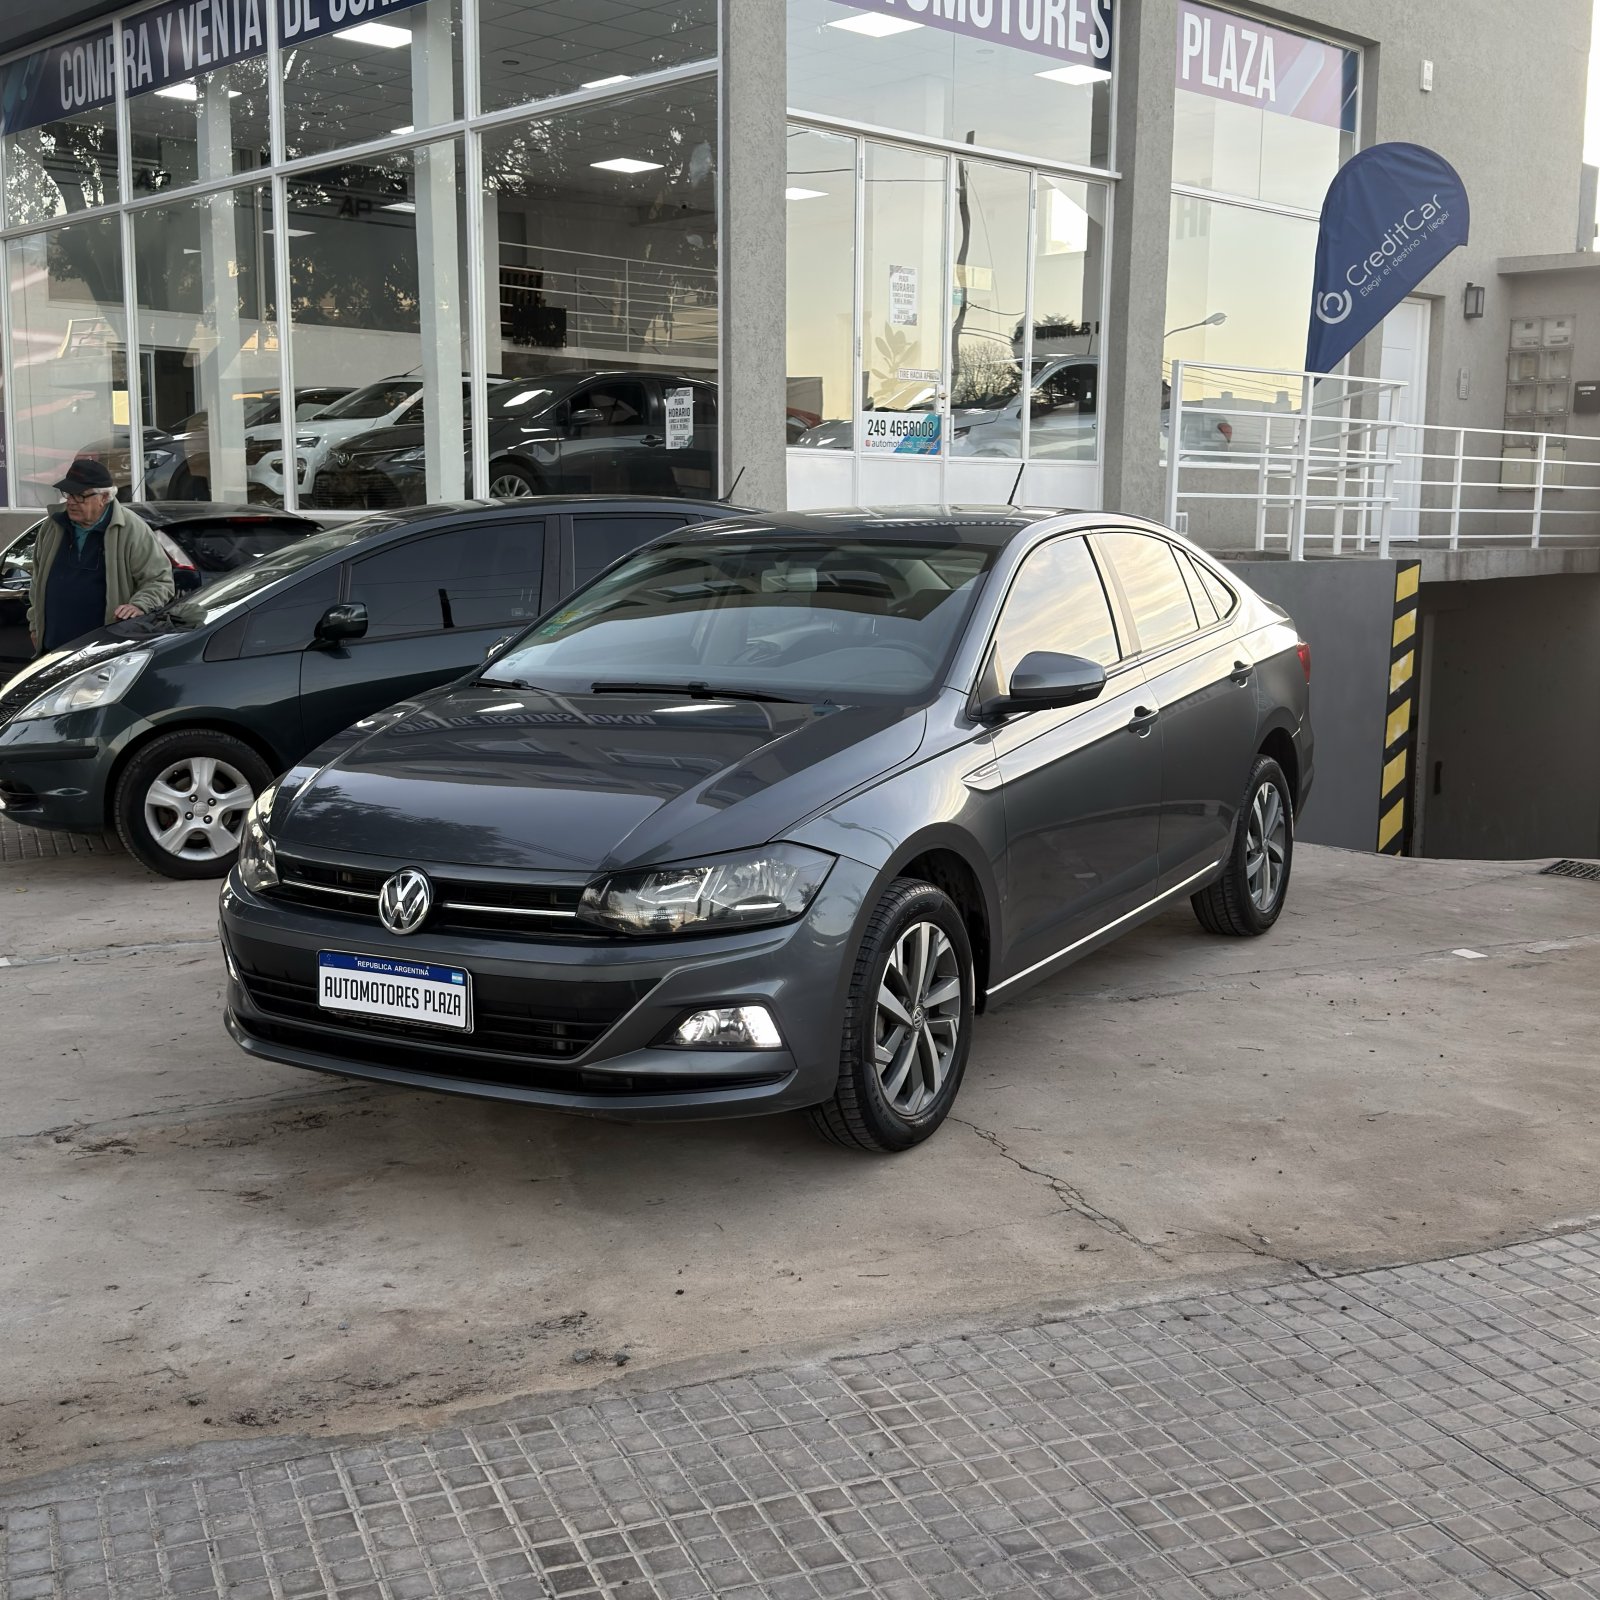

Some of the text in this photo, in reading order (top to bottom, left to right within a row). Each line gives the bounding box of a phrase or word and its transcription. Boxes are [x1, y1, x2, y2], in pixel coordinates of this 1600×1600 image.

[156, 12, 173, 78] Y
[178, 0, 263, 71] VENTA
[1182, 12, 1276, 102] PLAZA
[1346, 194, 1441, 286] CreditCar
[1360, 211, 1450, 297] Elegir el destino y llegar
[668, 407, 690, 417] HORARIO
[867, 419, 934, 437] 249 4658008
[324, 976, 461, 1017] AUTOMOTORES PLAZA
[357, 960, 429, 976] REPUBLICA ARGENTINA
